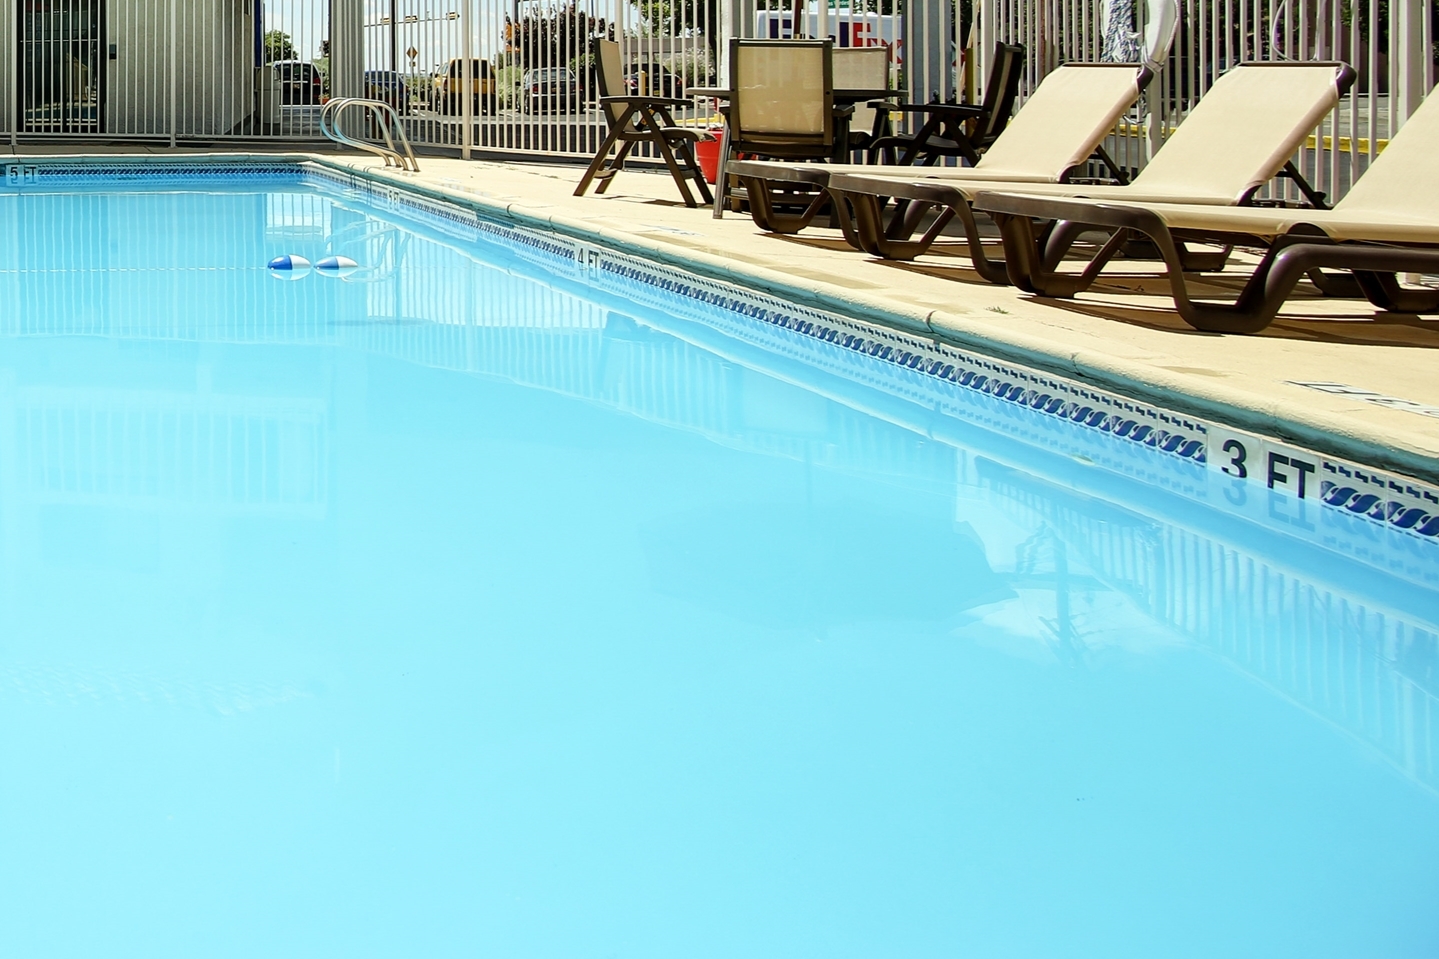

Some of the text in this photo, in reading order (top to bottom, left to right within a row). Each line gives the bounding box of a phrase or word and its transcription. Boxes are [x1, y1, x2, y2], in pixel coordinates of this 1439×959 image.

[10, 166, 37, 177] 5 FT
[578, 248, 599, 269] 4 FT
[1221, 438, 1316, 500] 3 FT
